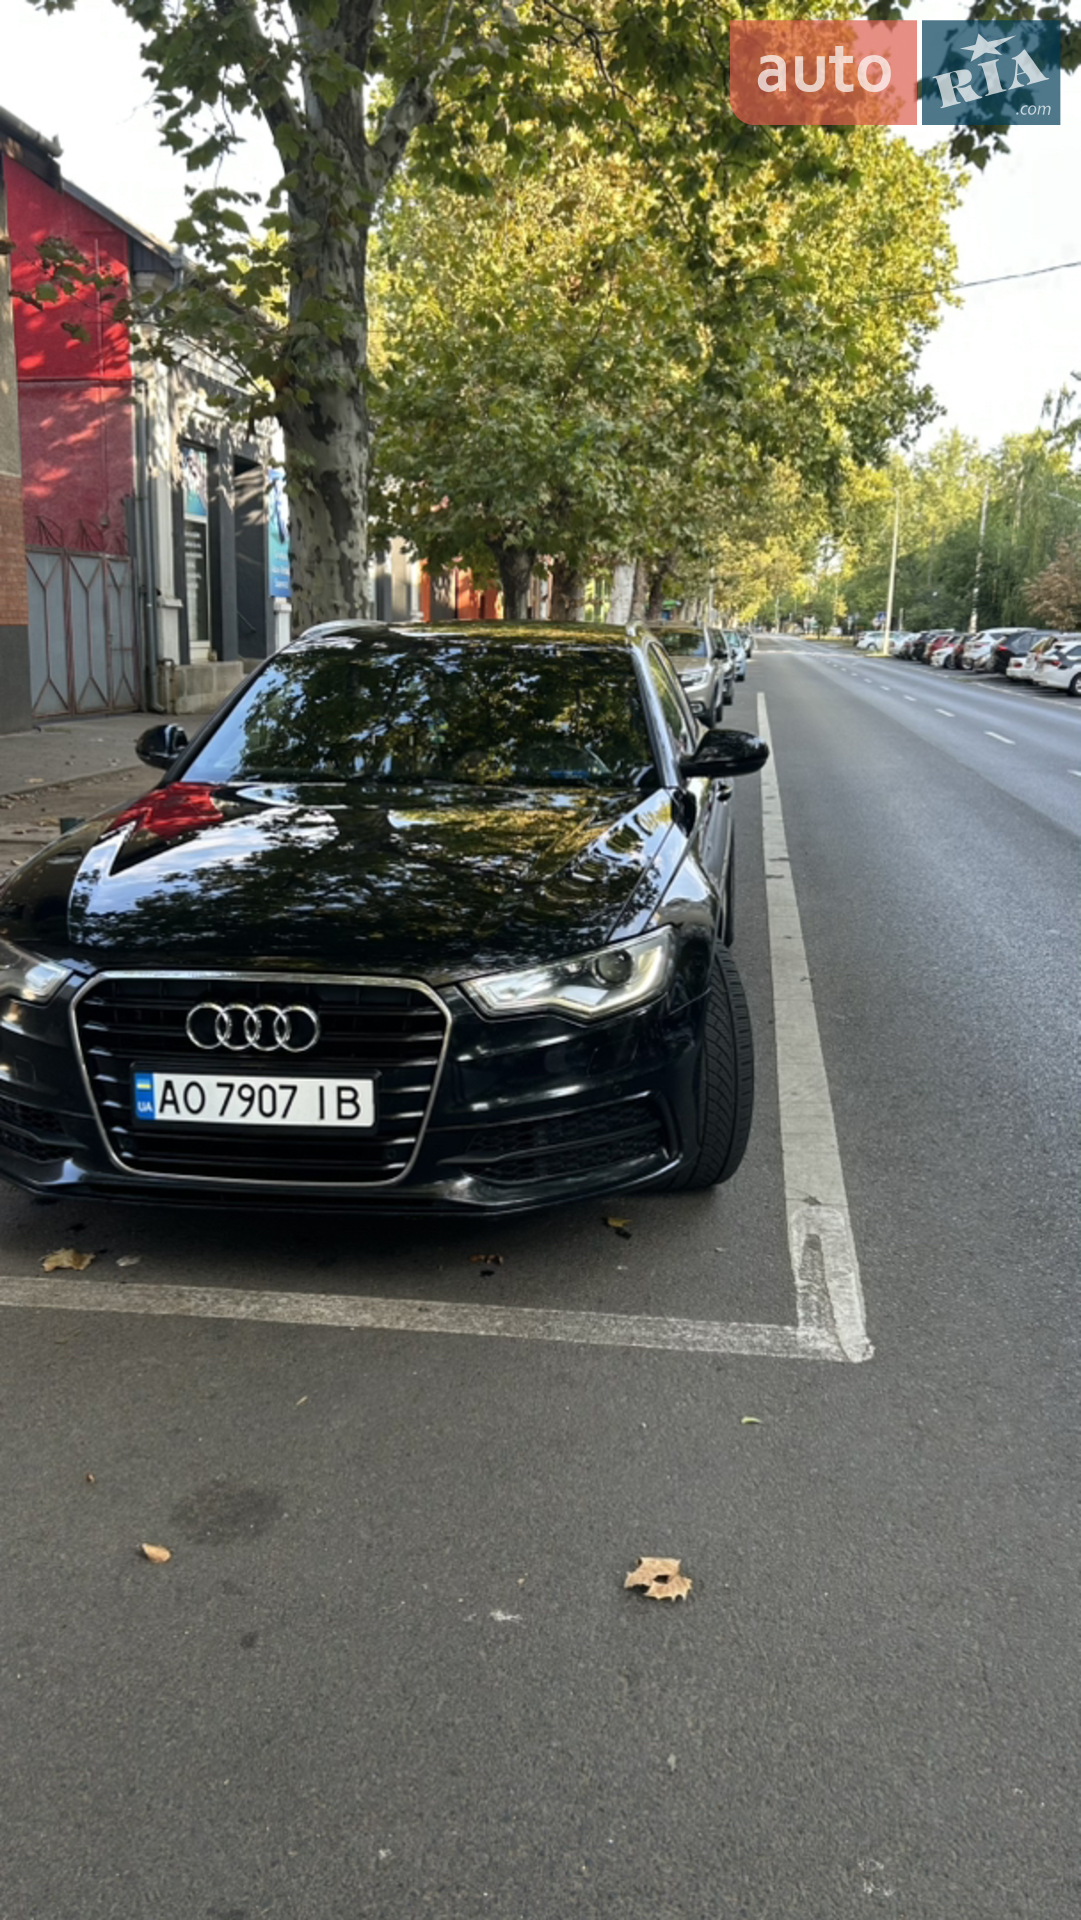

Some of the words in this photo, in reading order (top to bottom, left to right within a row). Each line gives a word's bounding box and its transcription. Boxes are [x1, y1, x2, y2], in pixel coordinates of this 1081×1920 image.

[137, 1101, 153, 1112] UA
[159, 1080, 206, 1115] AO
[216, 1082, 298, 1119] 7907
[319, 1085, 361, 1120] IB
